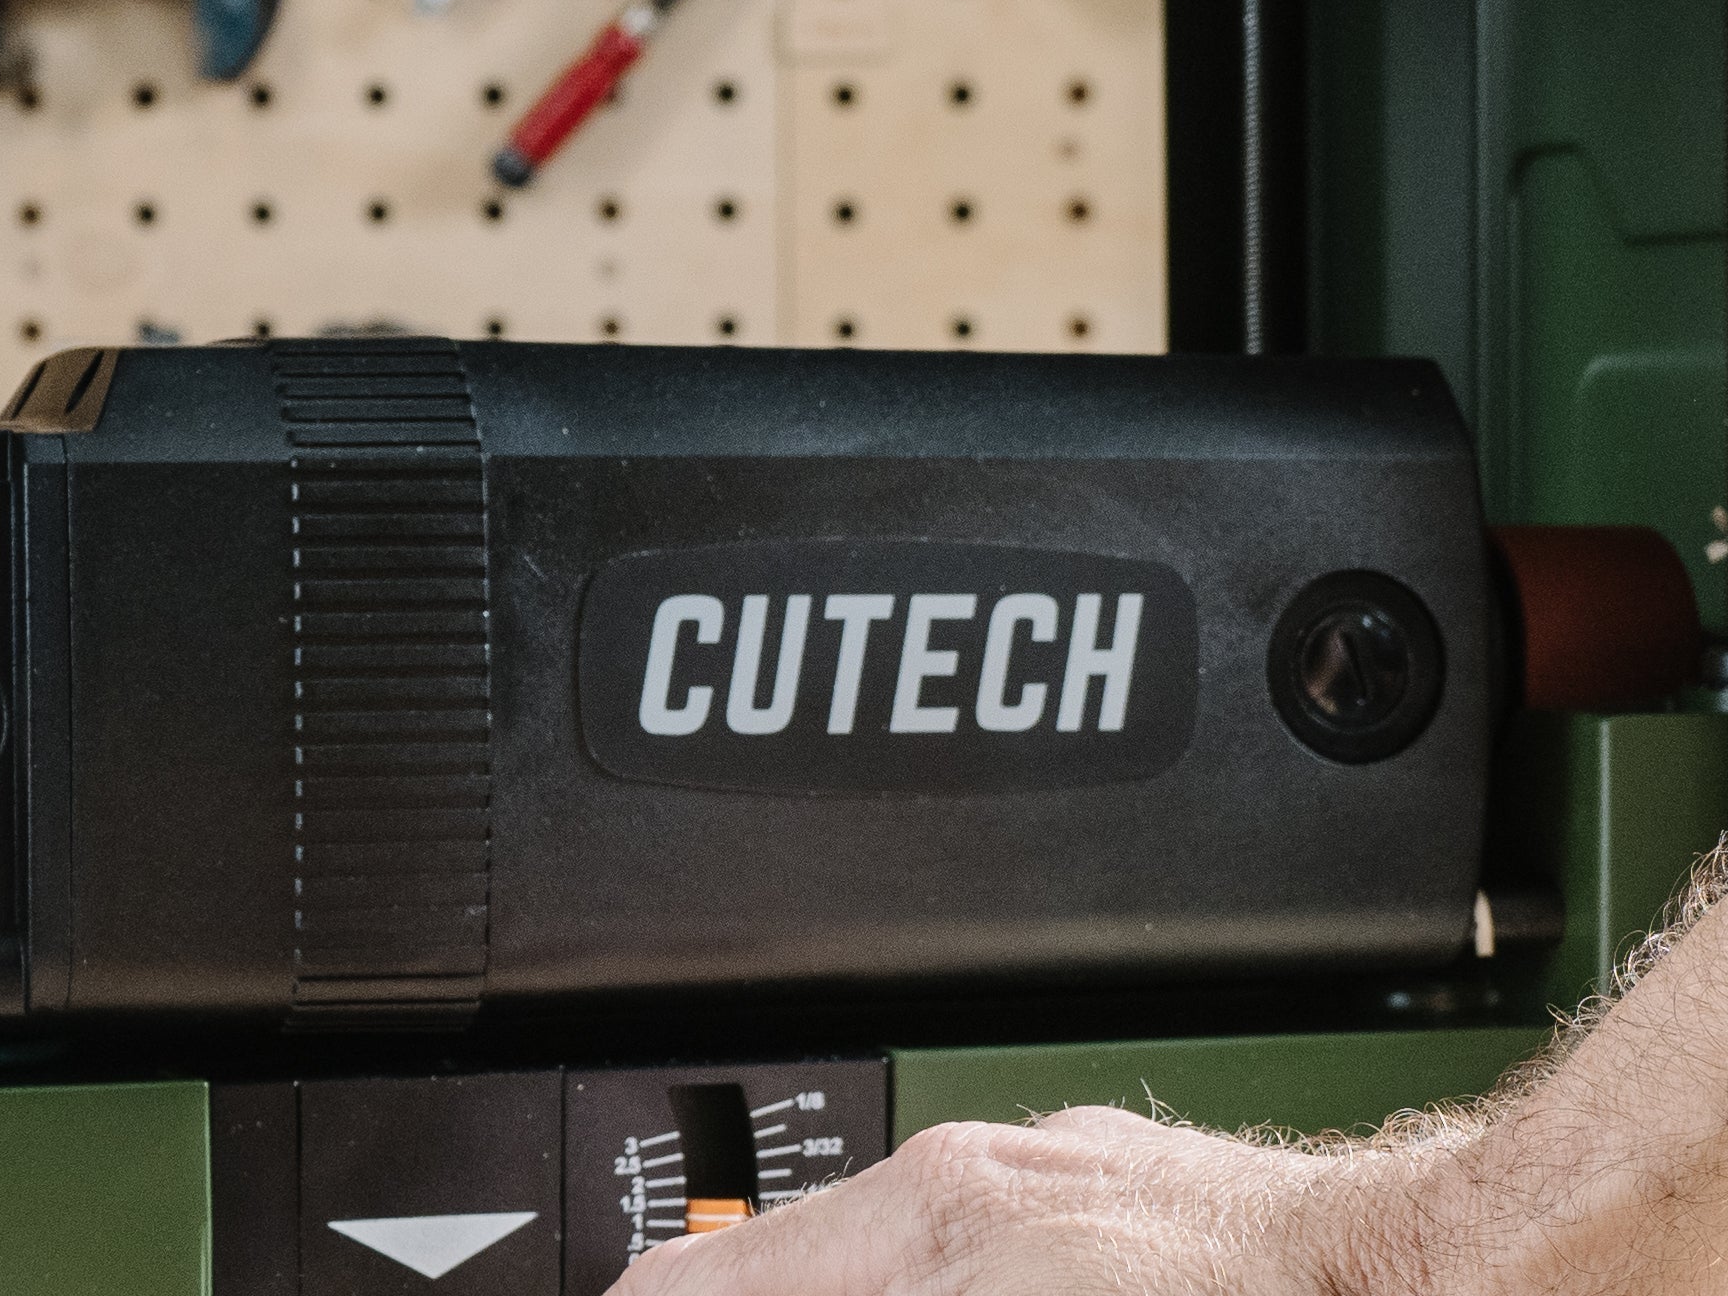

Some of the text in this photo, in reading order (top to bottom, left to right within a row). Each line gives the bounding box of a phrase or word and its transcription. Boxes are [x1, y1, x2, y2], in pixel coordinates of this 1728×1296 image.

[638, 593, 1145, 737] CUTECH
[624, 1136, 638, 1155] 3
[802, 1136, 844, 1157] 3/32
[631, 1176, 645, 1194] 2
